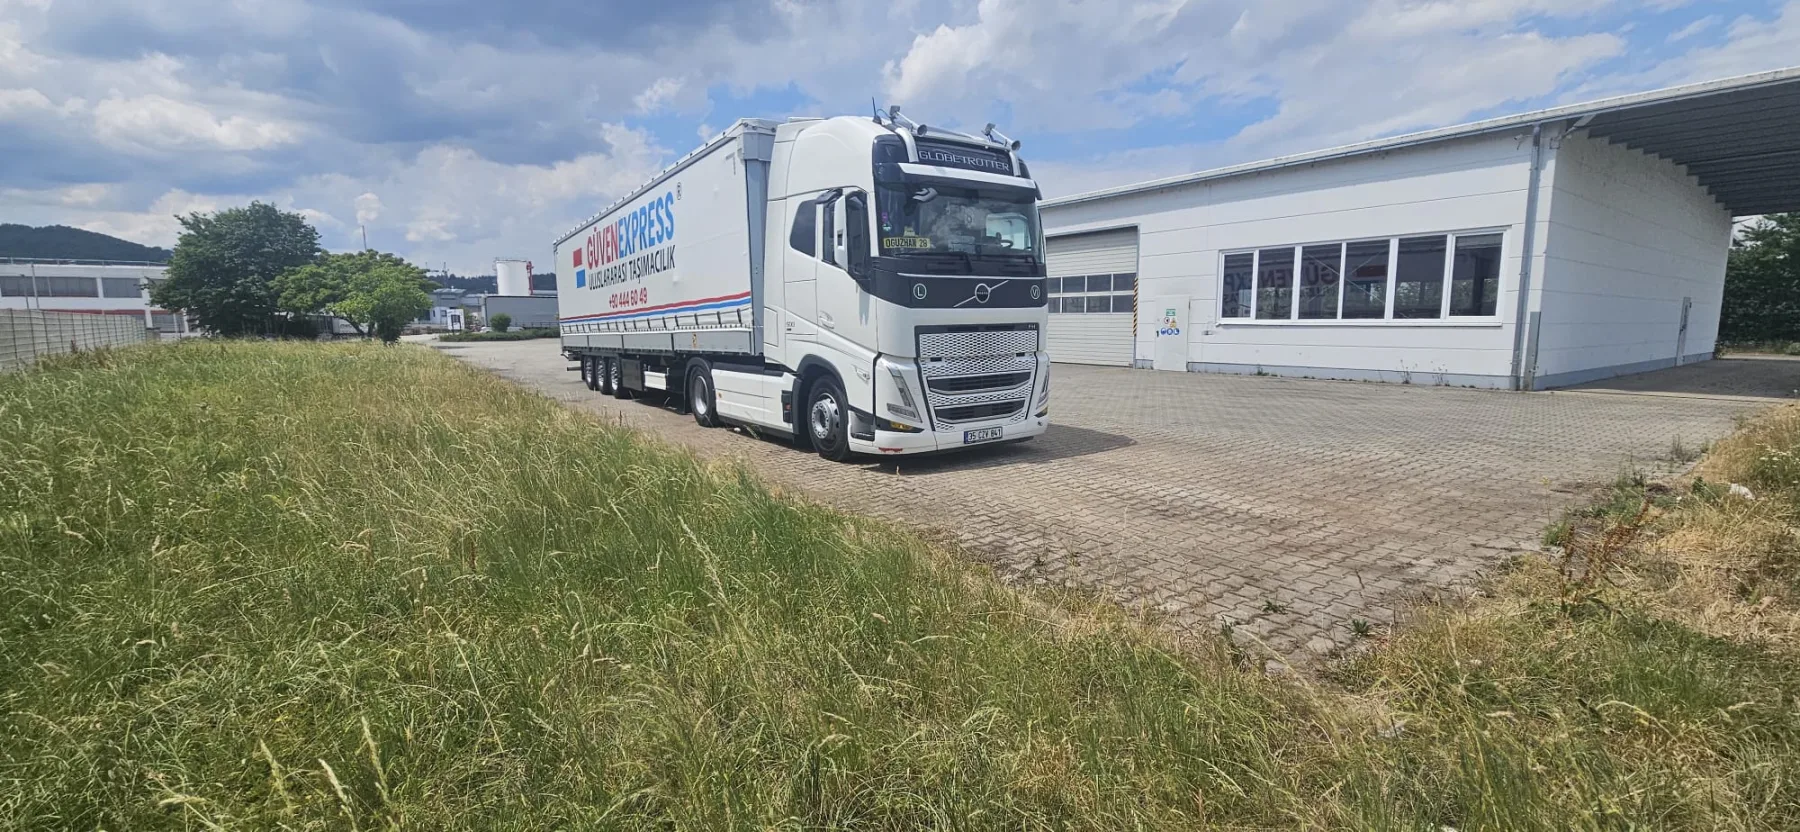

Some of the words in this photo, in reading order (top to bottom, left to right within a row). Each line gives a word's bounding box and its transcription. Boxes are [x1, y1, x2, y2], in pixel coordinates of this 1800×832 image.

[919, 151, 1010, 171] GLOBETROTTER
[587, 191, 674, 270] GÜVENEXPRESS
[589, 262, 627, 290] ULUSLARARASI
[629, 245, 676, 284] TAŞIMACILIK
[619, 291, 630, 308] 444
[639, 287, 648, 304] 49
